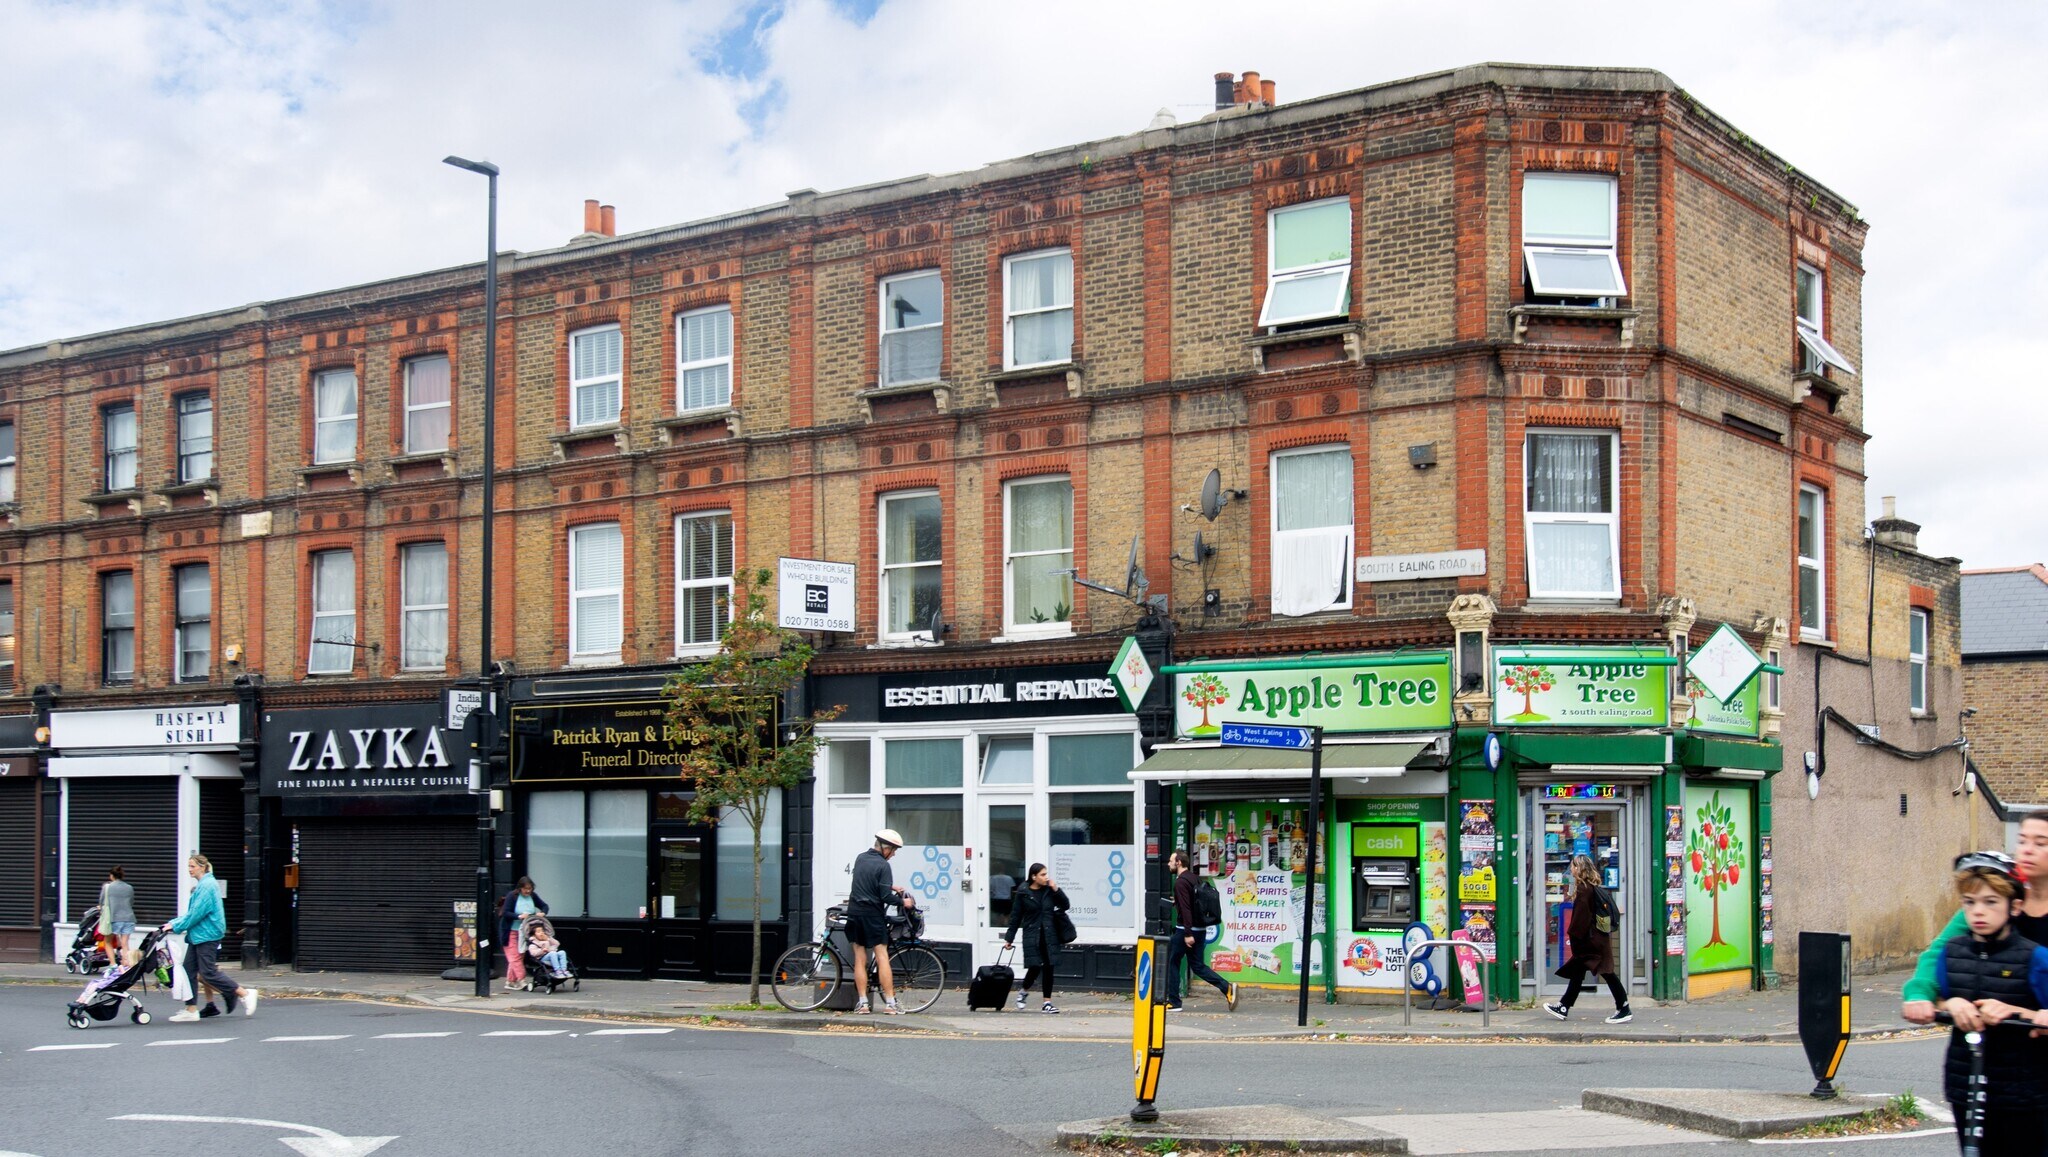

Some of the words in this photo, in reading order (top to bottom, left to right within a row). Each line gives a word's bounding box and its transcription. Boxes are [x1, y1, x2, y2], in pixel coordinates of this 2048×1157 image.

[783, 561, 821, 571] INVESTMENT
[823, 564, 836, 573] FOR
[837, 566, 852, 575] SALE
[1360, 563, 1394, 575] SOUTH
[1399, 560, 1435, 573] EALING
[1439, 557, 1468, 570] ROAD
[787, 572, 813, 582] WHOLE
[815, 574, 848, 585] BUILDING
[785, 616, 802, 626] 020
[804, 617, 825, 628] 7183
[827, 619, 849, 630] 0588
[457, 693, 482, 703] India
[884, 683, 1011, 707] ESSENTIAL
[1016, 678, 1118, 701] REPAIRS
[1237, 675, 1343, 719] Apple
[1353, 672, 1438, 707] Tree
[1577, 683, 1637, 703] Tree
[156, 711, 225, 726] HASE-YA
[1570, 708, 1597, 716] south
[1599, 708, 1628, 717] ealing
[1631, 708, 1653, 716] road
[166, 728, 213, 744] SUSHI
[553, 727, 600, 746] Patrick
[605, 726, 640, 748] Ryan
[644, 725, 658, 743] &
[1243, 728, 1261, 736] West
[1263, 729, 1284, 738] Ealing
[1243, 736, 1270, 745] Perivale
[288, 725, 452, 771] ZAYKA
[582, 749, 632, 768] Funeral
[278, 780, 301, 788] FINE
[306, 779, 345, 788] INDIAN
[350, 779, 357, 787] &
[363, 777, 416, 787] NEPALESE
[421, 776, 469, 786] CUISINE
[1387, 802, 1420, 810] OPENING
[1366, 834, 1404, 850] cash
[965, 863, 971, 876] 4
[1238, 911, 1277, 919] LOTTERY
[1226, 922, 1247, 931] MILK
[1248, 922, 1255, 931] &
[1257, 922, 1288, 932] BREAD
[1237, 934, 1279, 943] GROCERY
[1385, 947, 1403, 955] THE
[1385, 955, 1406, 963] NATI
